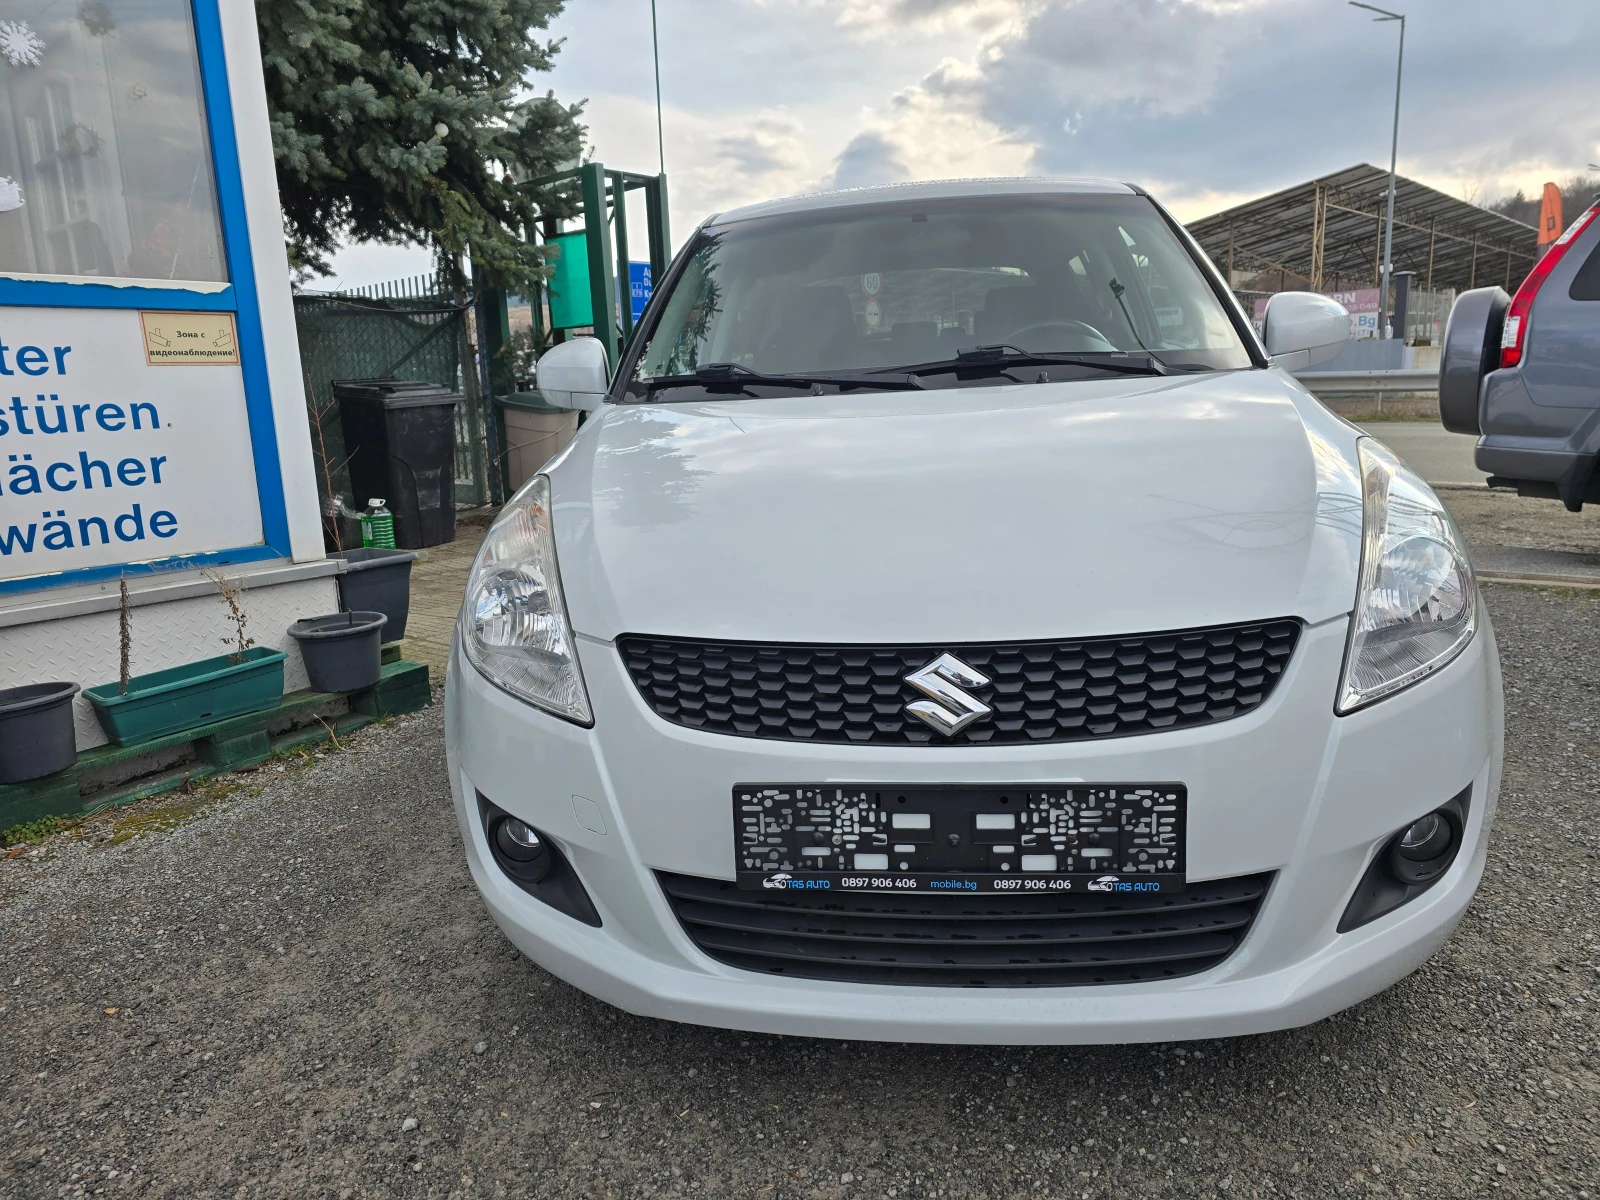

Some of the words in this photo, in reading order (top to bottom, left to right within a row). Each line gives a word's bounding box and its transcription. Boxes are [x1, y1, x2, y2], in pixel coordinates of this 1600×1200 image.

[150, 349, 235, 357] видеонаблюдение!
[0, 451, 167, 496] ächer
[806, 880, 831, 889] AUTO
[841, 877, 869, 887] 0897
[871, 878, 893, 887] 906
[894, 878, 917, 888] 406
[930, 879, 977, 891] mobile.bg
[993, 879, 1022, 889] 0897
[1024, 879, 1047, 889] 906
[1049, 879, 1072, 889] 406
[1134, 882, 1160, 891] AUTO
